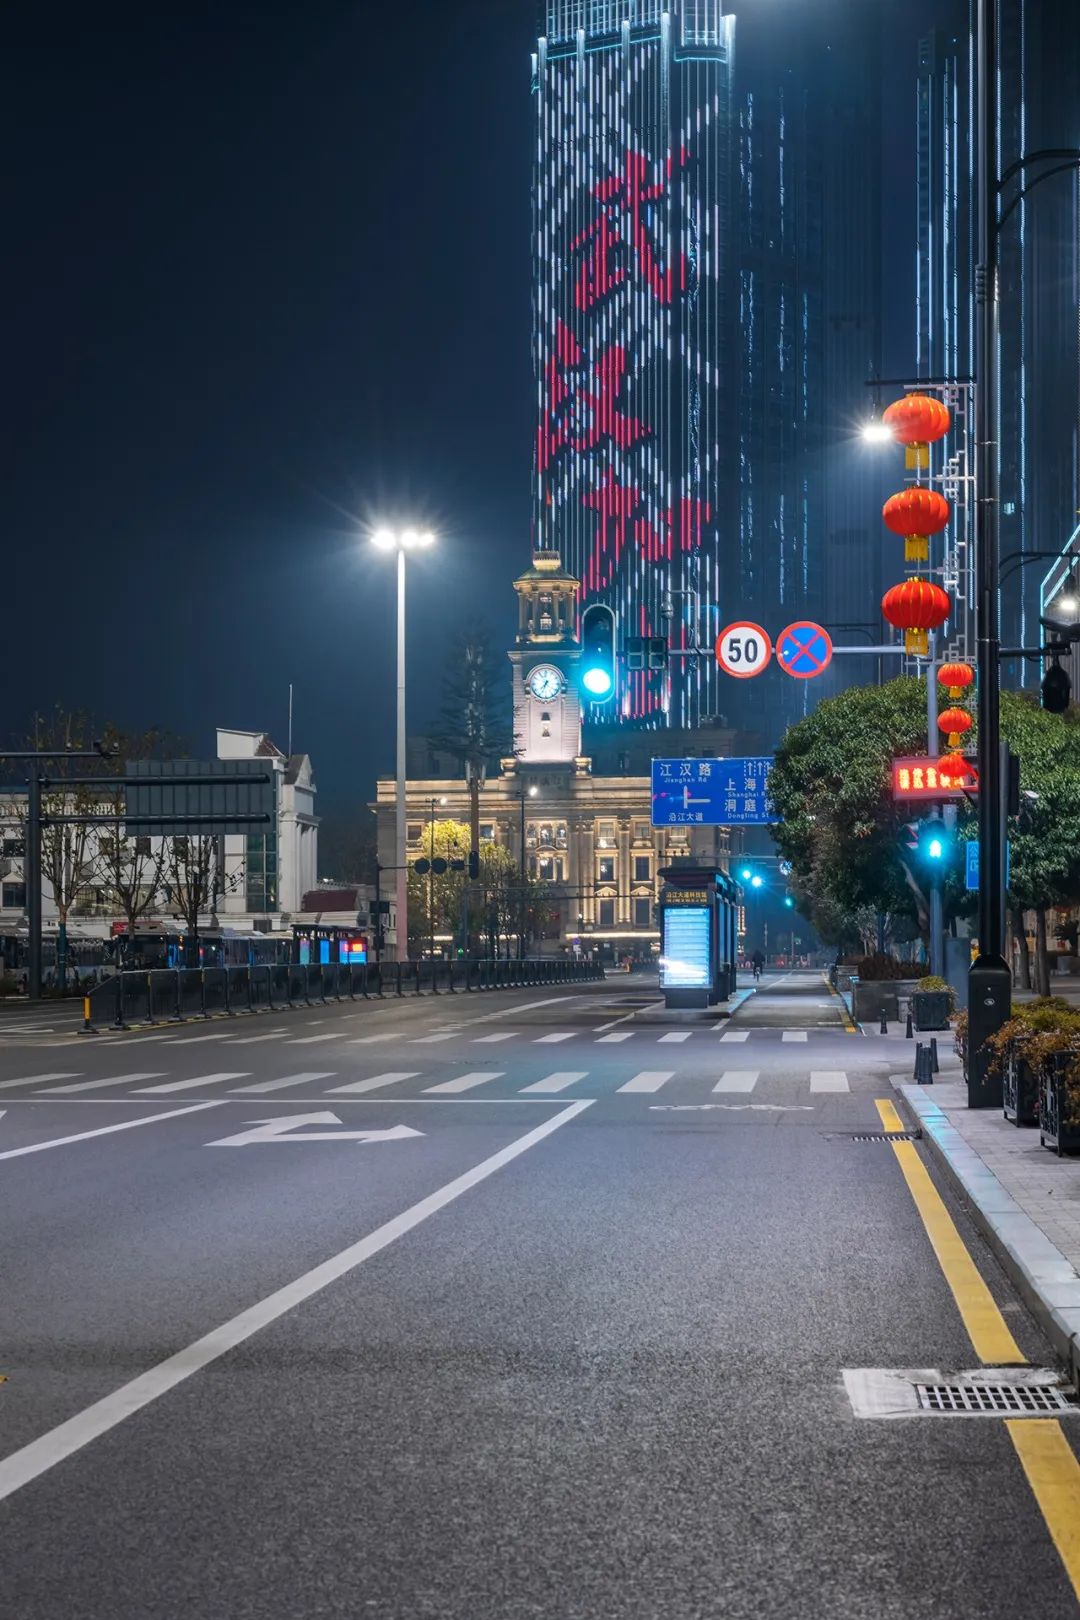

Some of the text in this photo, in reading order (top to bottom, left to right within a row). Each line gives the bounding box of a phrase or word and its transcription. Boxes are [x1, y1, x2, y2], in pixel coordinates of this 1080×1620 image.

[728, 638, 758, 663] 50
[660, 763, 711, 776] 江汉路
[668, 812, 704, 822] 沿江大道
